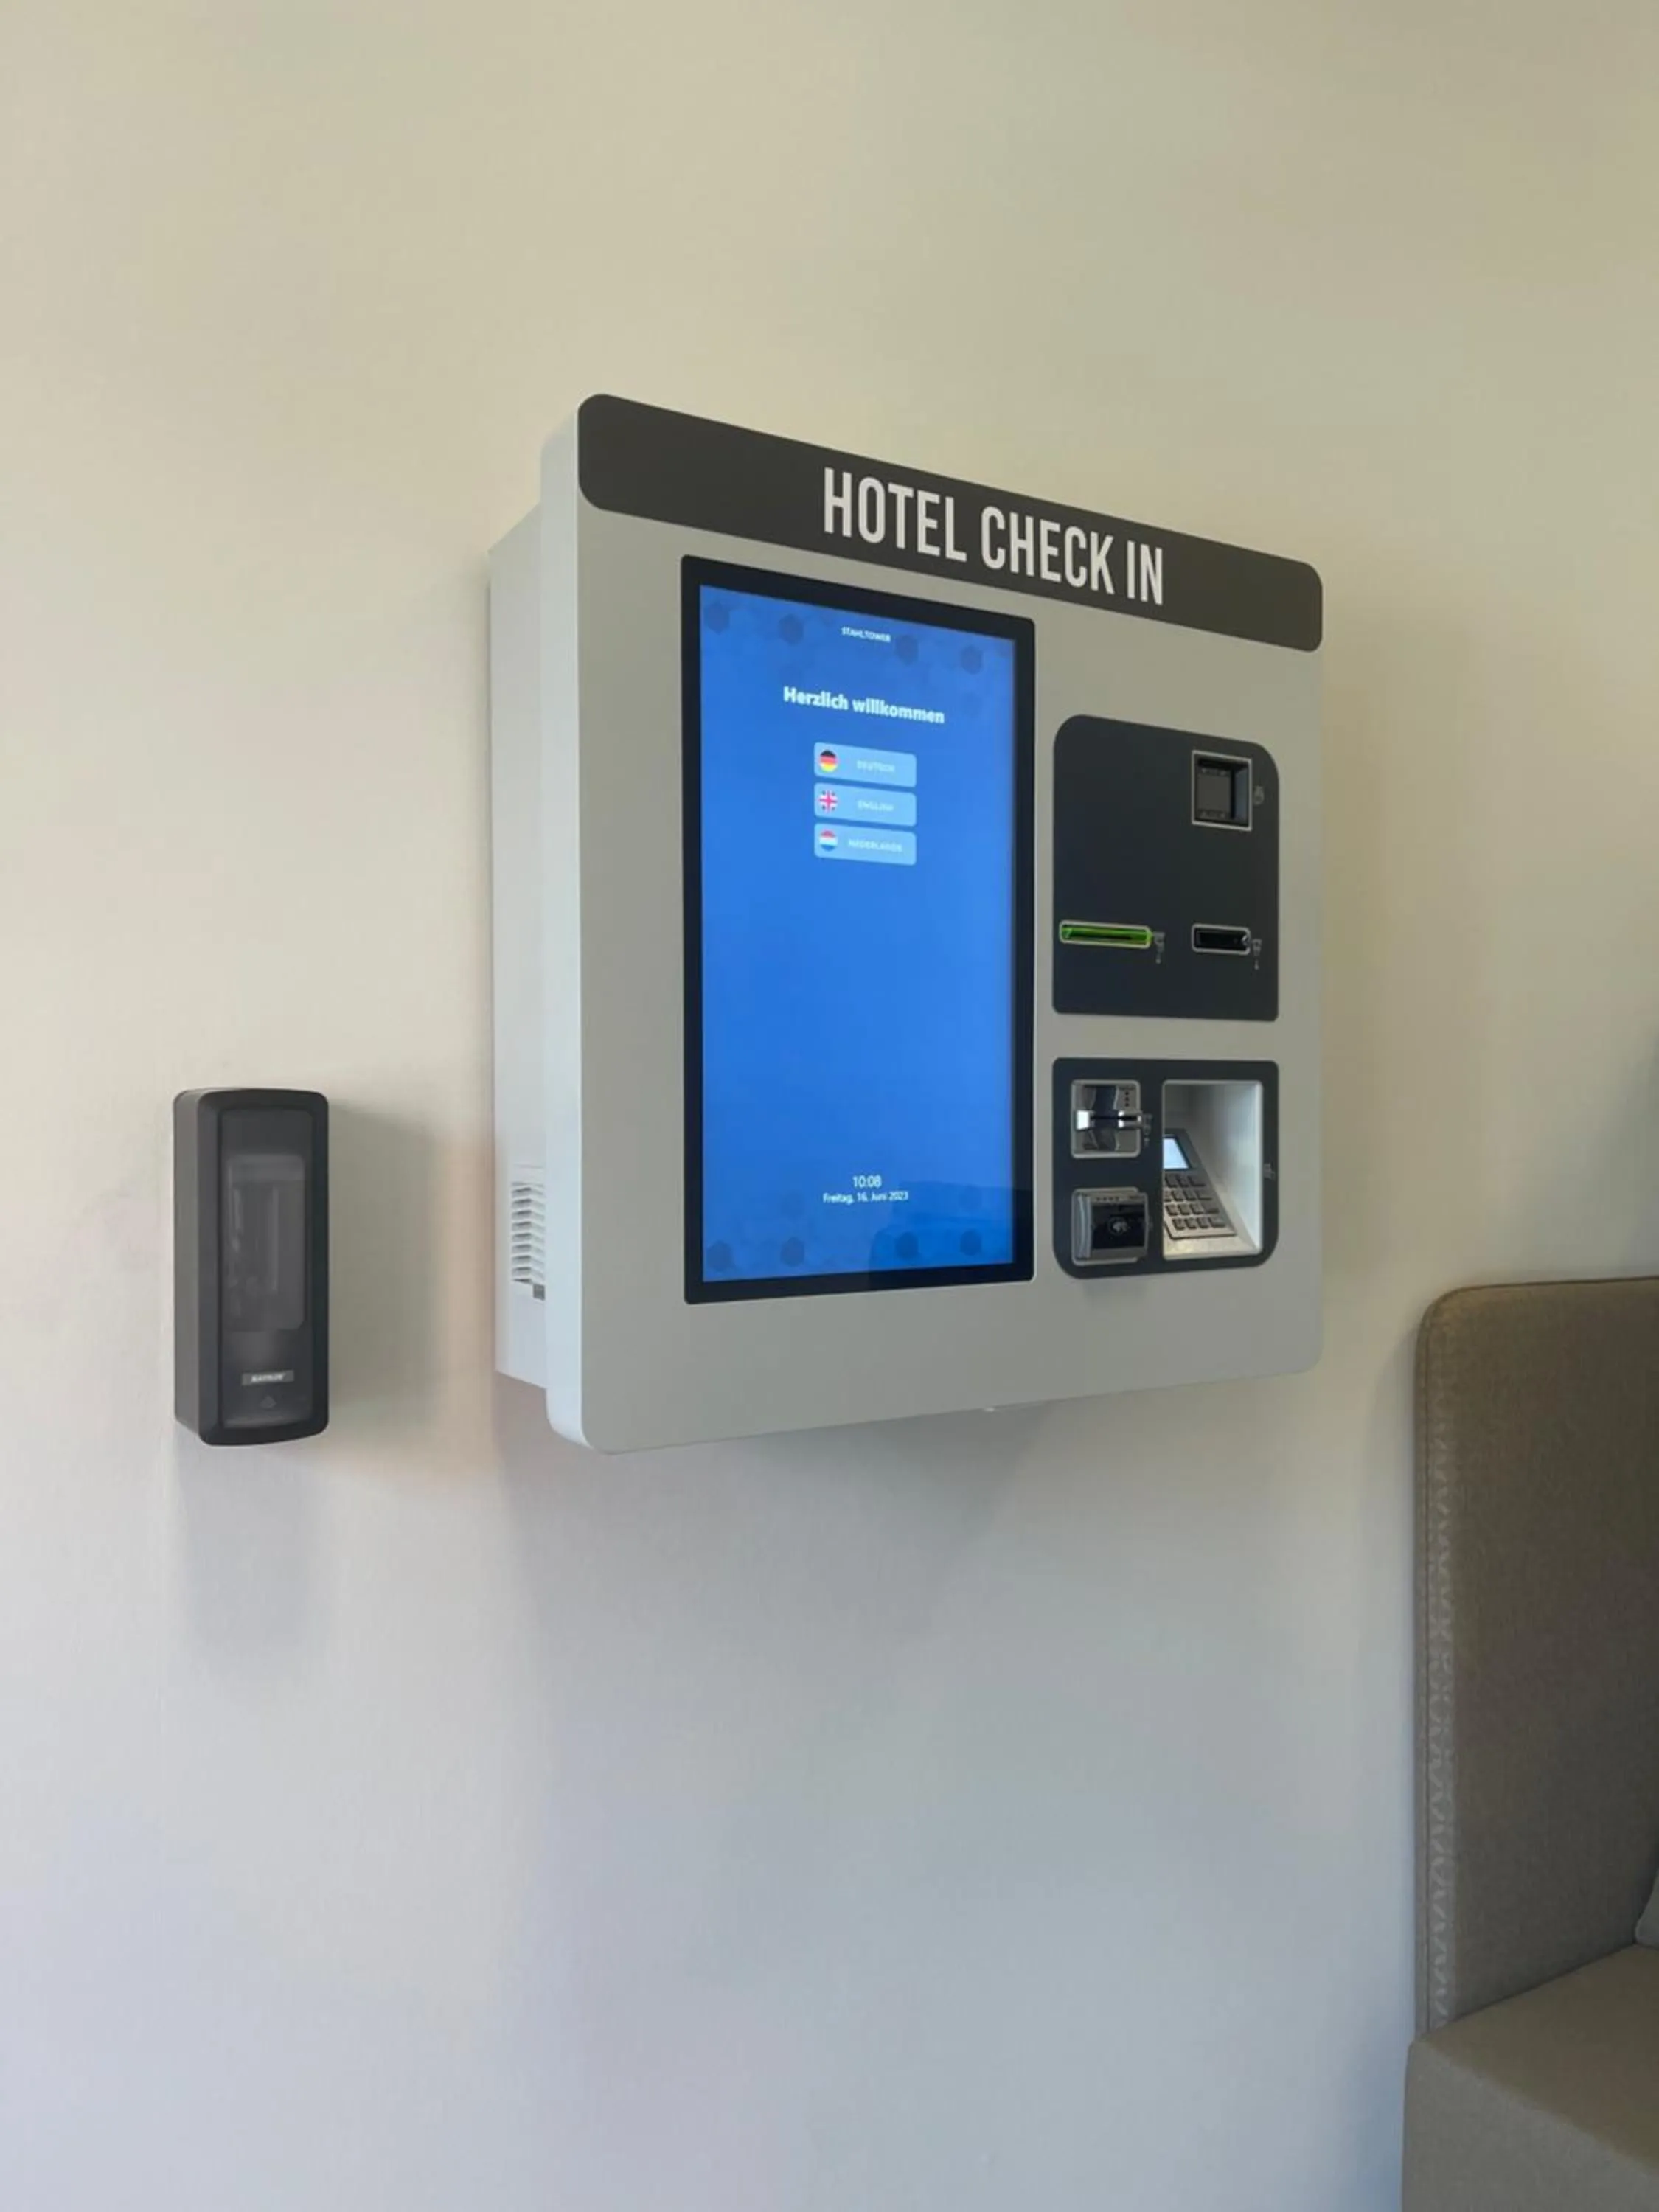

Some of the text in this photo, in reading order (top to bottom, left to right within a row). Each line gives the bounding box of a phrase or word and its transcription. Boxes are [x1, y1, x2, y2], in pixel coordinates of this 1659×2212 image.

[824, 467, 1164, 605] HOTEL CHECK IN
[783, 686, 945, 724] Herzlich willkommen
[852, 1175, 883, 1189] 10:08
[870, 1191, 888, 1202] Juni
[888, 1190, 909, 1201] 2023
